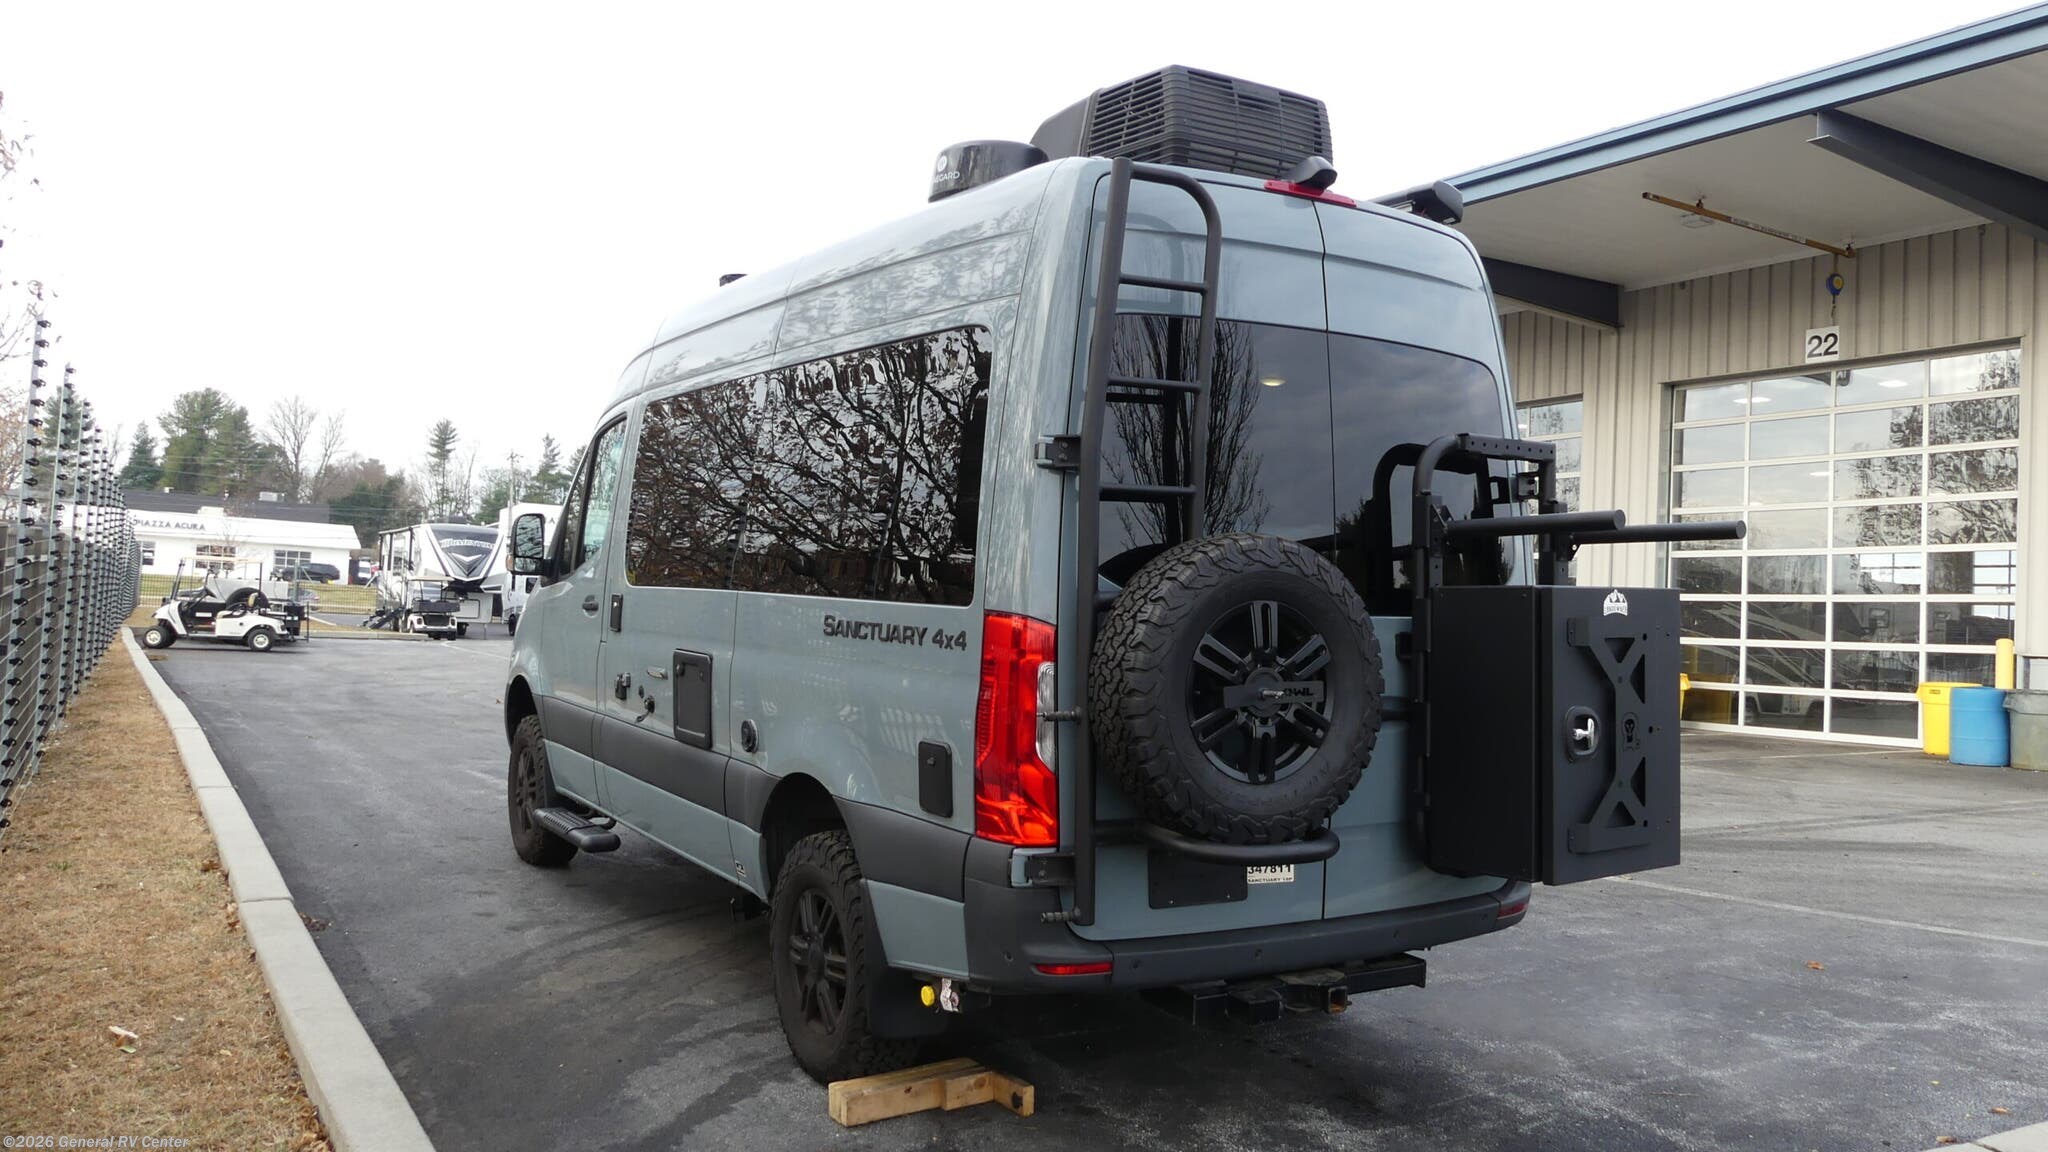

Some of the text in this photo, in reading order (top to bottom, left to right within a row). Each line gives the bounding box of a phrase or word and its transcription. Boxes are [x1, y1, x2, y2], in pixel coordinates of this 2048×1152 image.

[1807, 333, 1838, 357] 22
[174, 522, 206, 531] ACURA
[823, 614, 968, 650] SANCTUARY 4x4
